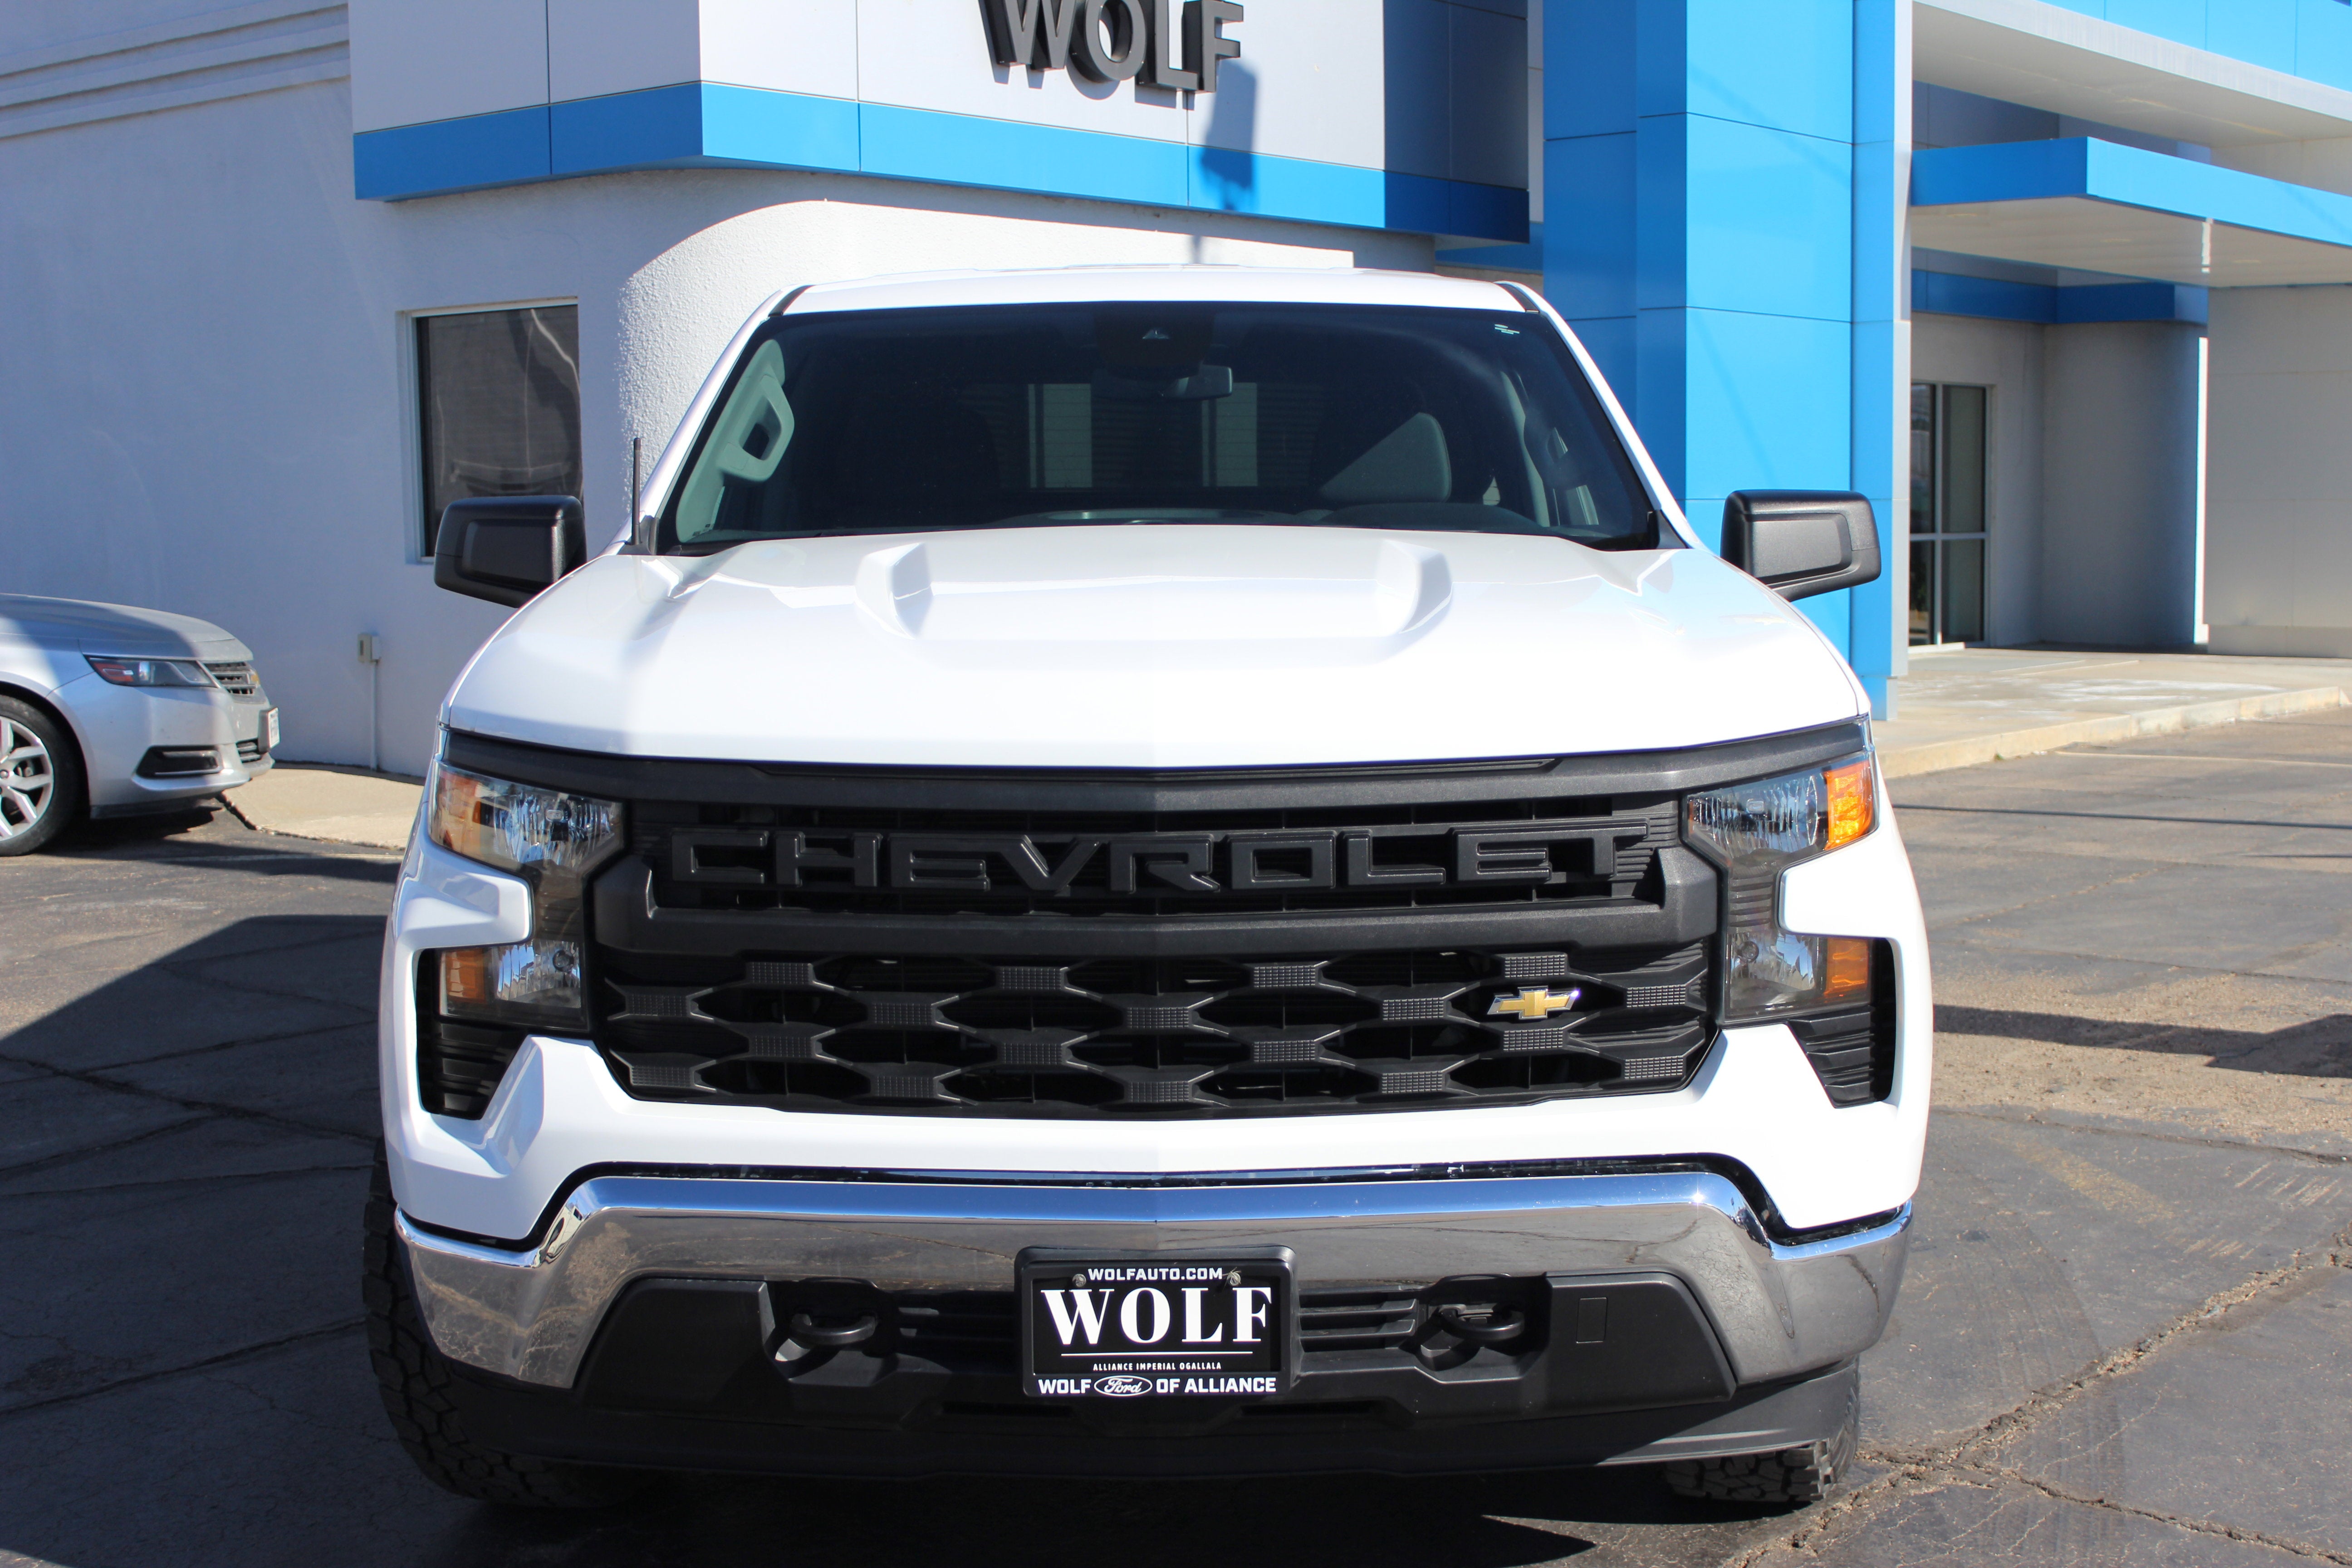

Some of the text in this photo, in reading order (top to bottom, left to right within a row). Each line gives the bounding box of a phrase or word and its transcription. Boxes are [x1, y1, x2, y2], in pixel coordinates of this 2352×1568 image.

[985, 0, 1244, 93] WOLF
[671, 818, 1651, 894] CHEVROLET
[1088, 1267, 1223, 1281] WOLFAUTO.COM
[1040, 1287, 1272, 1345] WOLF
[1093, 1362, 1221, 1371] ALLIANCE IMPERIAL OGALLALA
[1038, 1377, 1277, 1395] WOLF Ford OF ALLIANCE
